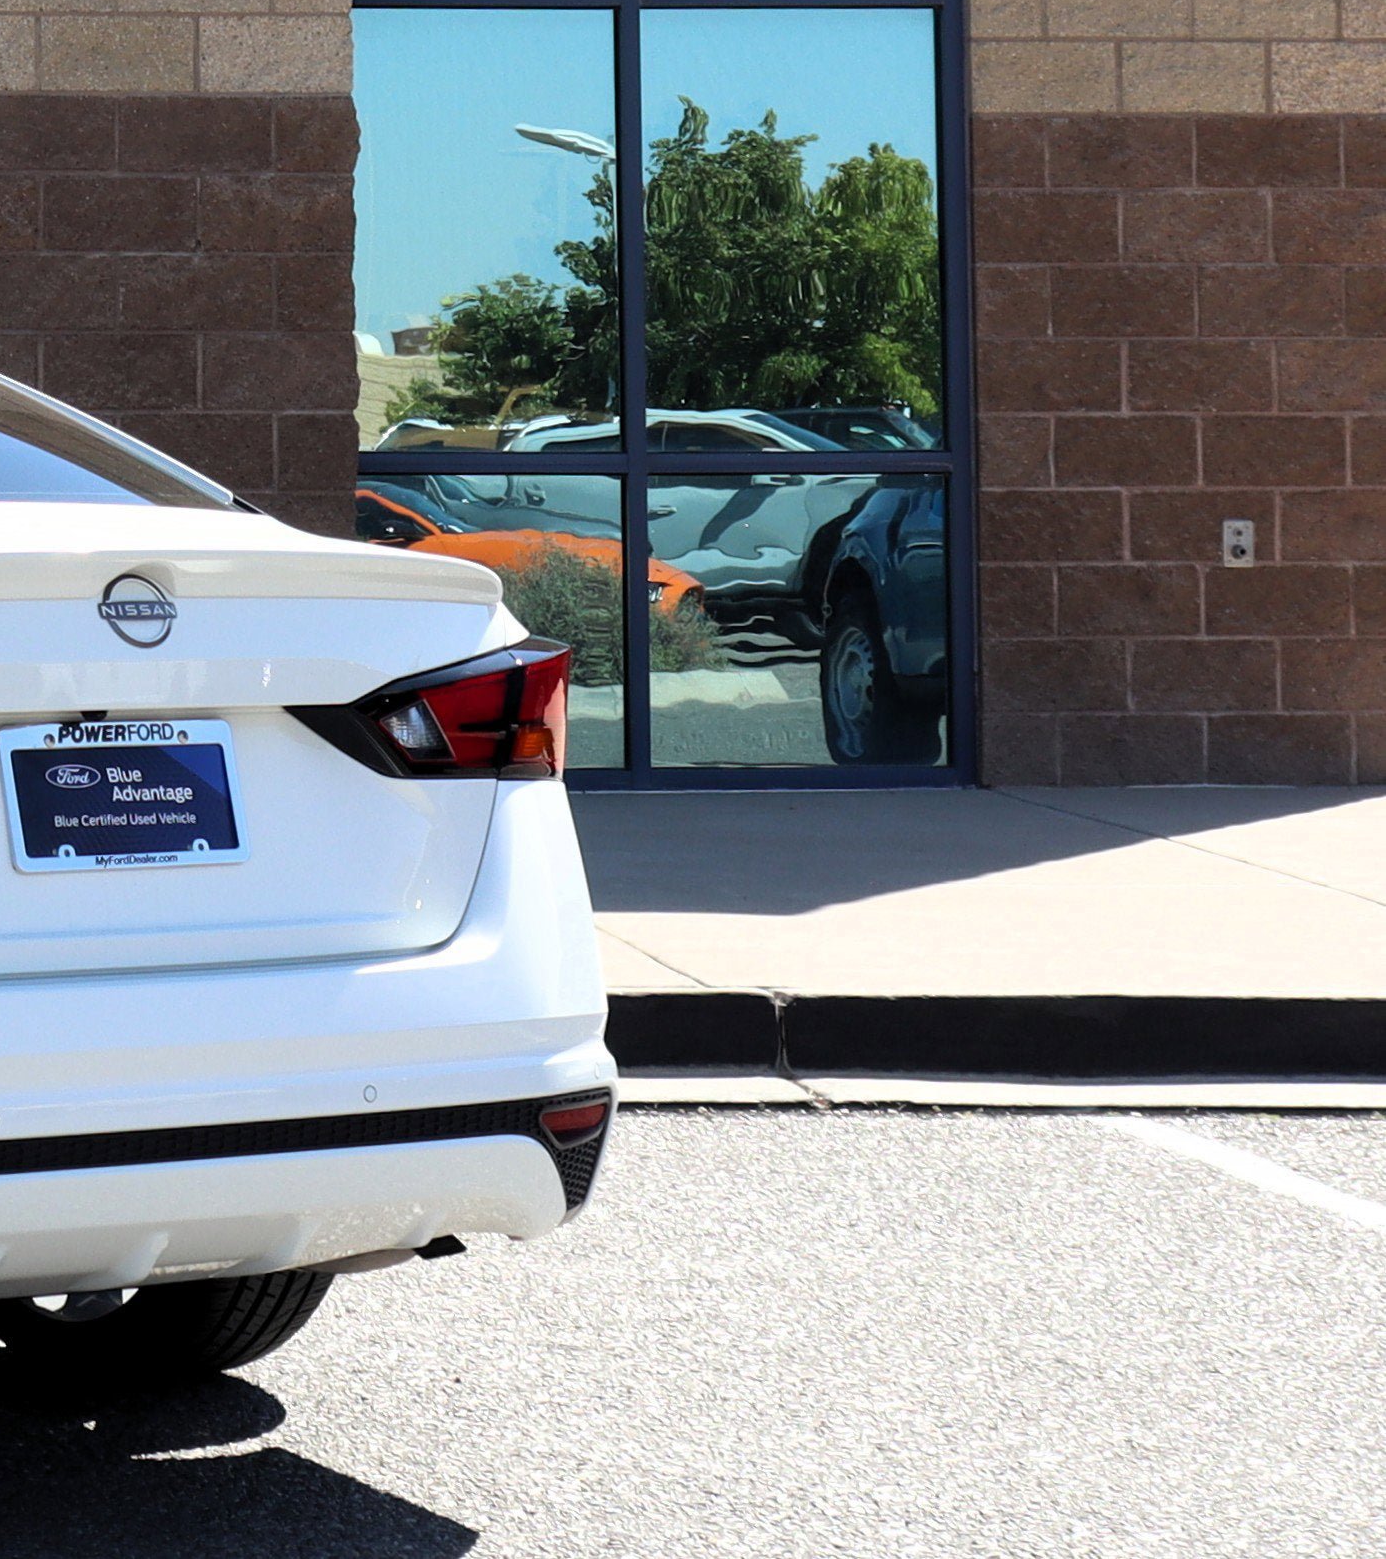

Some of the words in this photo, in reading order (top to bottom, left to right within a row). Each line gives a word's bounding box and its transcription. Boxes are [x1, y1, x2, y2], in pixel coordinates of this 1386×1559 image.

[100, 603, 177, 618] NISSAN
[57, 723, 175, 744] POWERFORD
[56, 767, 91, 785] Ford
[106, 767, 143, 783] Blue
[112, 785, 194, 804] Advantage
[54, 815, 79, 828] Blue
[81, 813, 127, 827] Certified
[129, 812, 157, 825] Used
[158, 811, 196, 825] Vehicle
[95, 854, 178, 868] MyFordDealer.com
